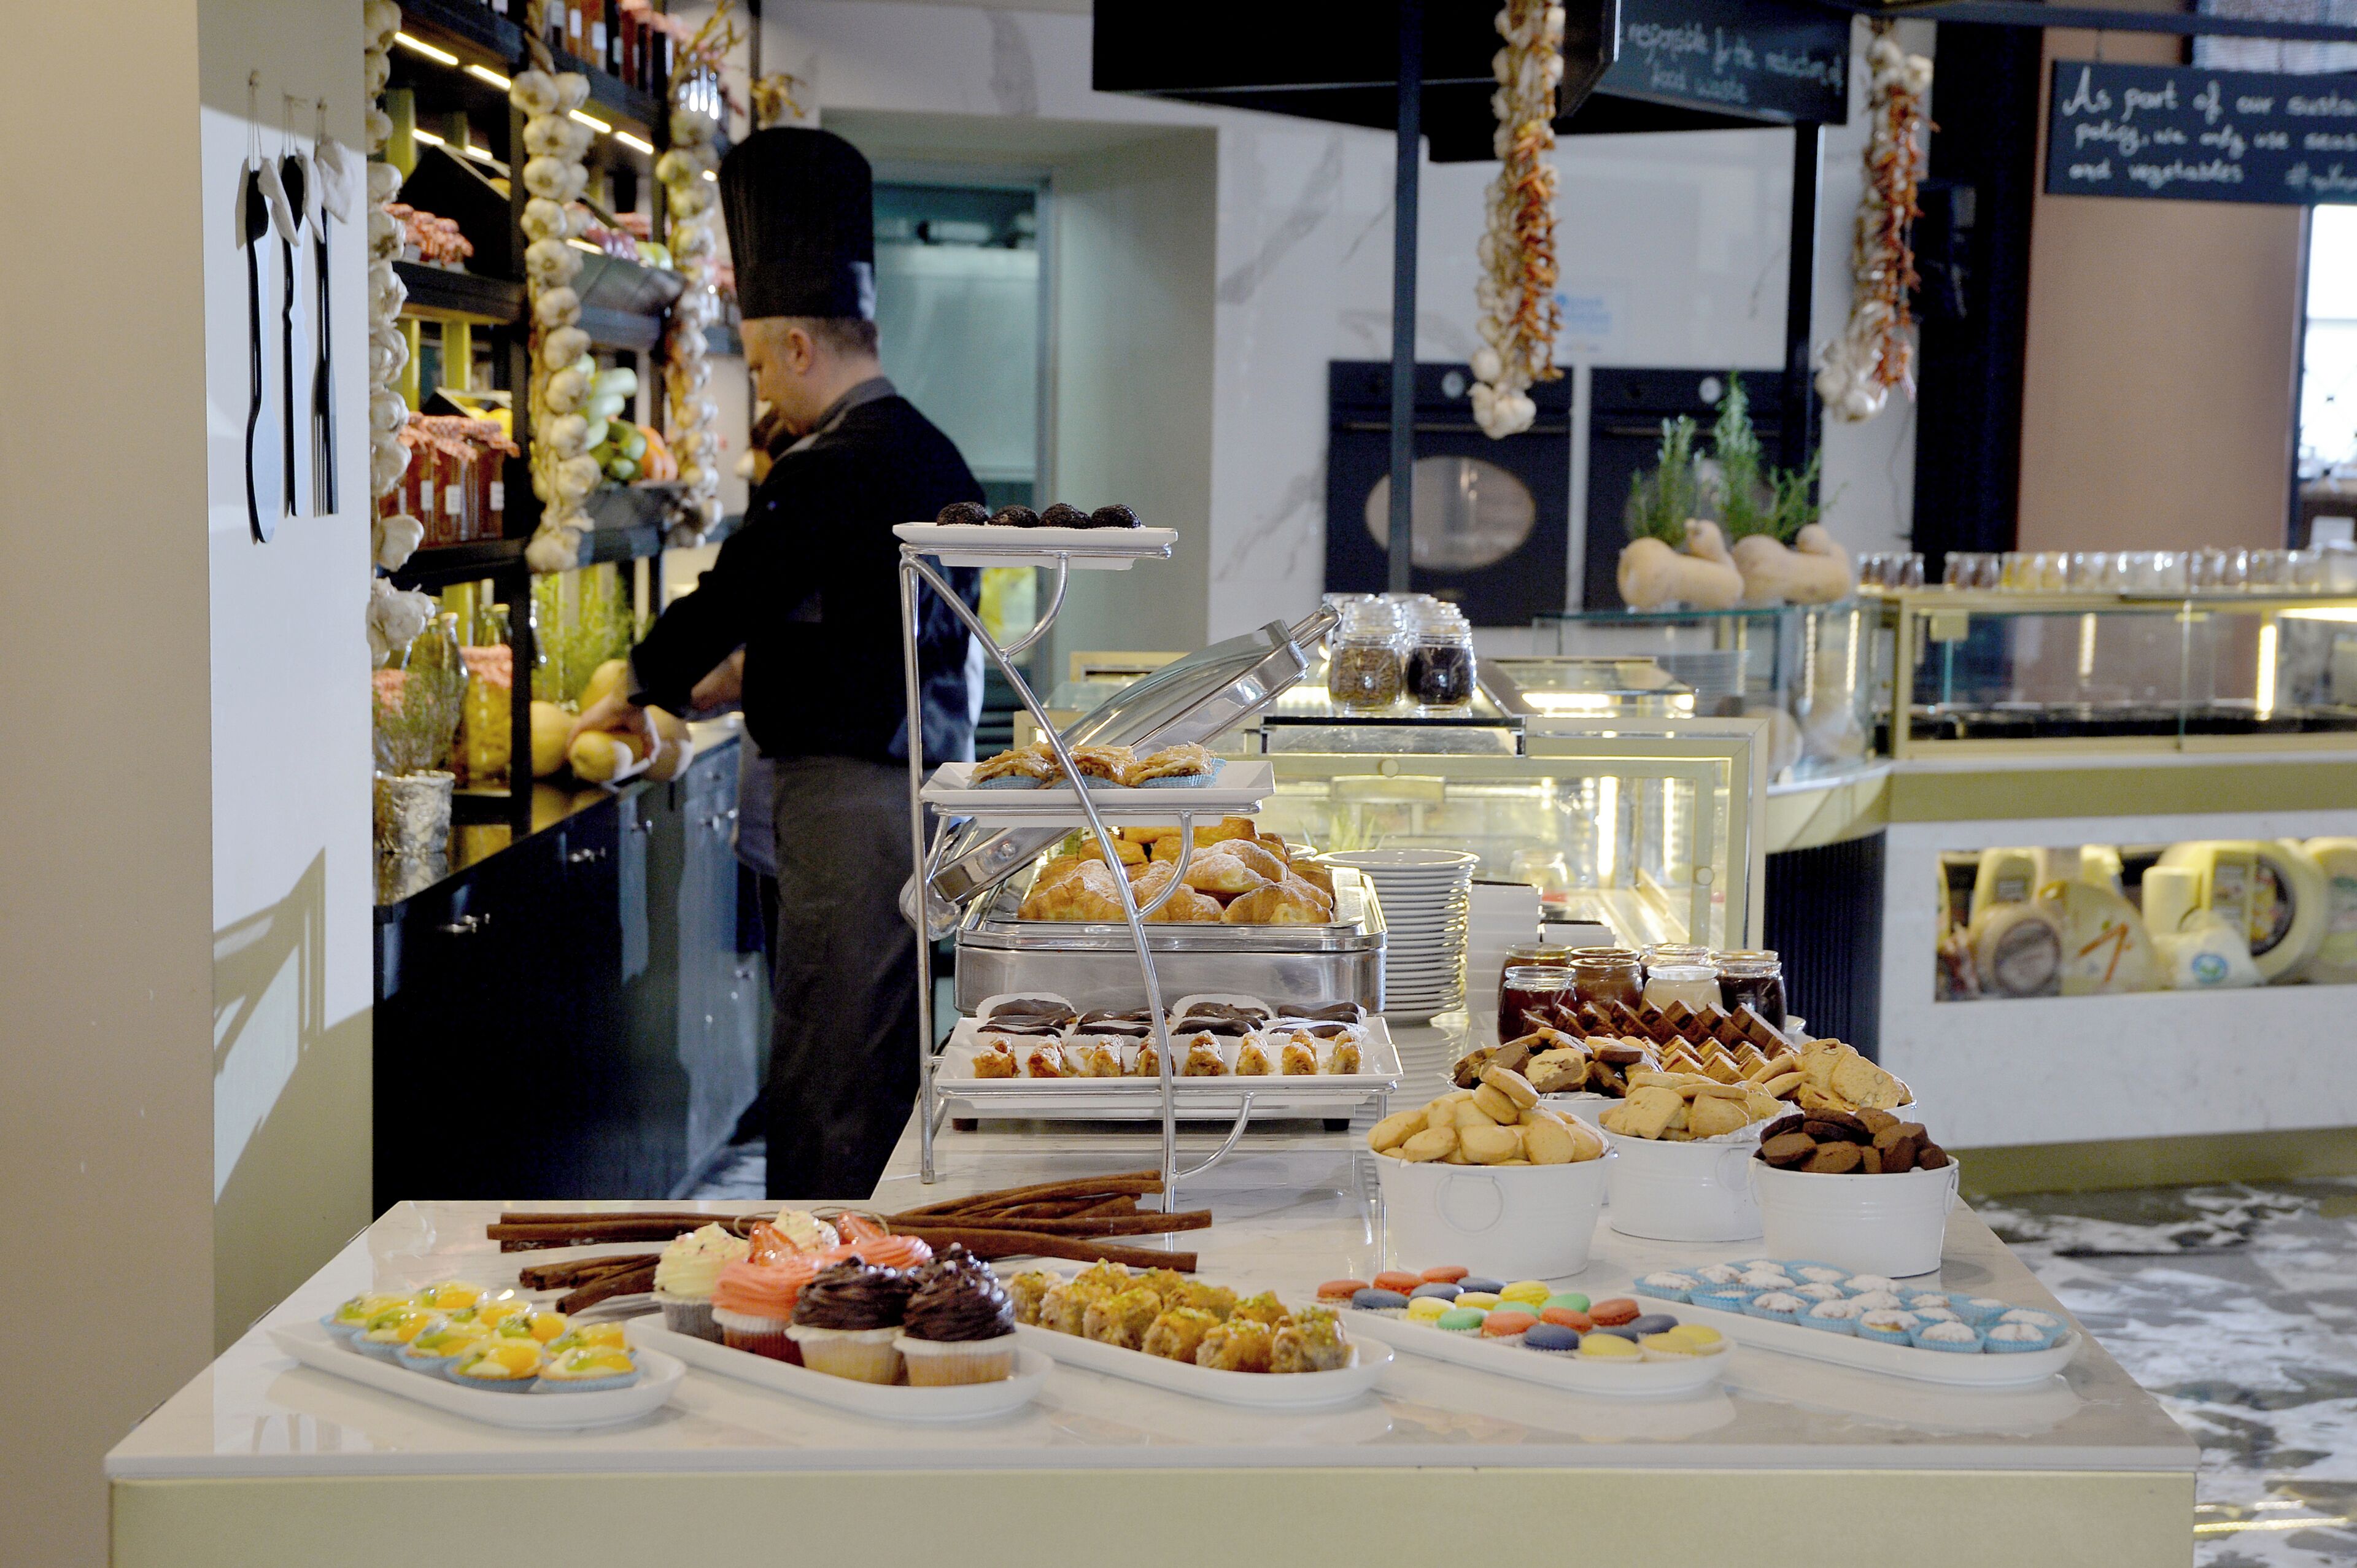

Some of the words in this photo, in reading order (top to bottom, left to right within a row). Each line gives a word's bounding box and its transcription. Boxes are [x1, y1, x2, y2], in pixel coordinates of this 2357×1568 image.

[2062, 66, 2112, 116] As
[2121, 80, 2178, 122] part
[2193, 80, 2224, 125] of
[2235, 95, 2275, 115] our
[2153, 126, 2189, 145] we
[2199, 123, 2247, 160] only
[2253, 131, 2289, 150] use
[2069, 156, 2111, 182] and
[2128, 158, 2244, 190] vegetables
